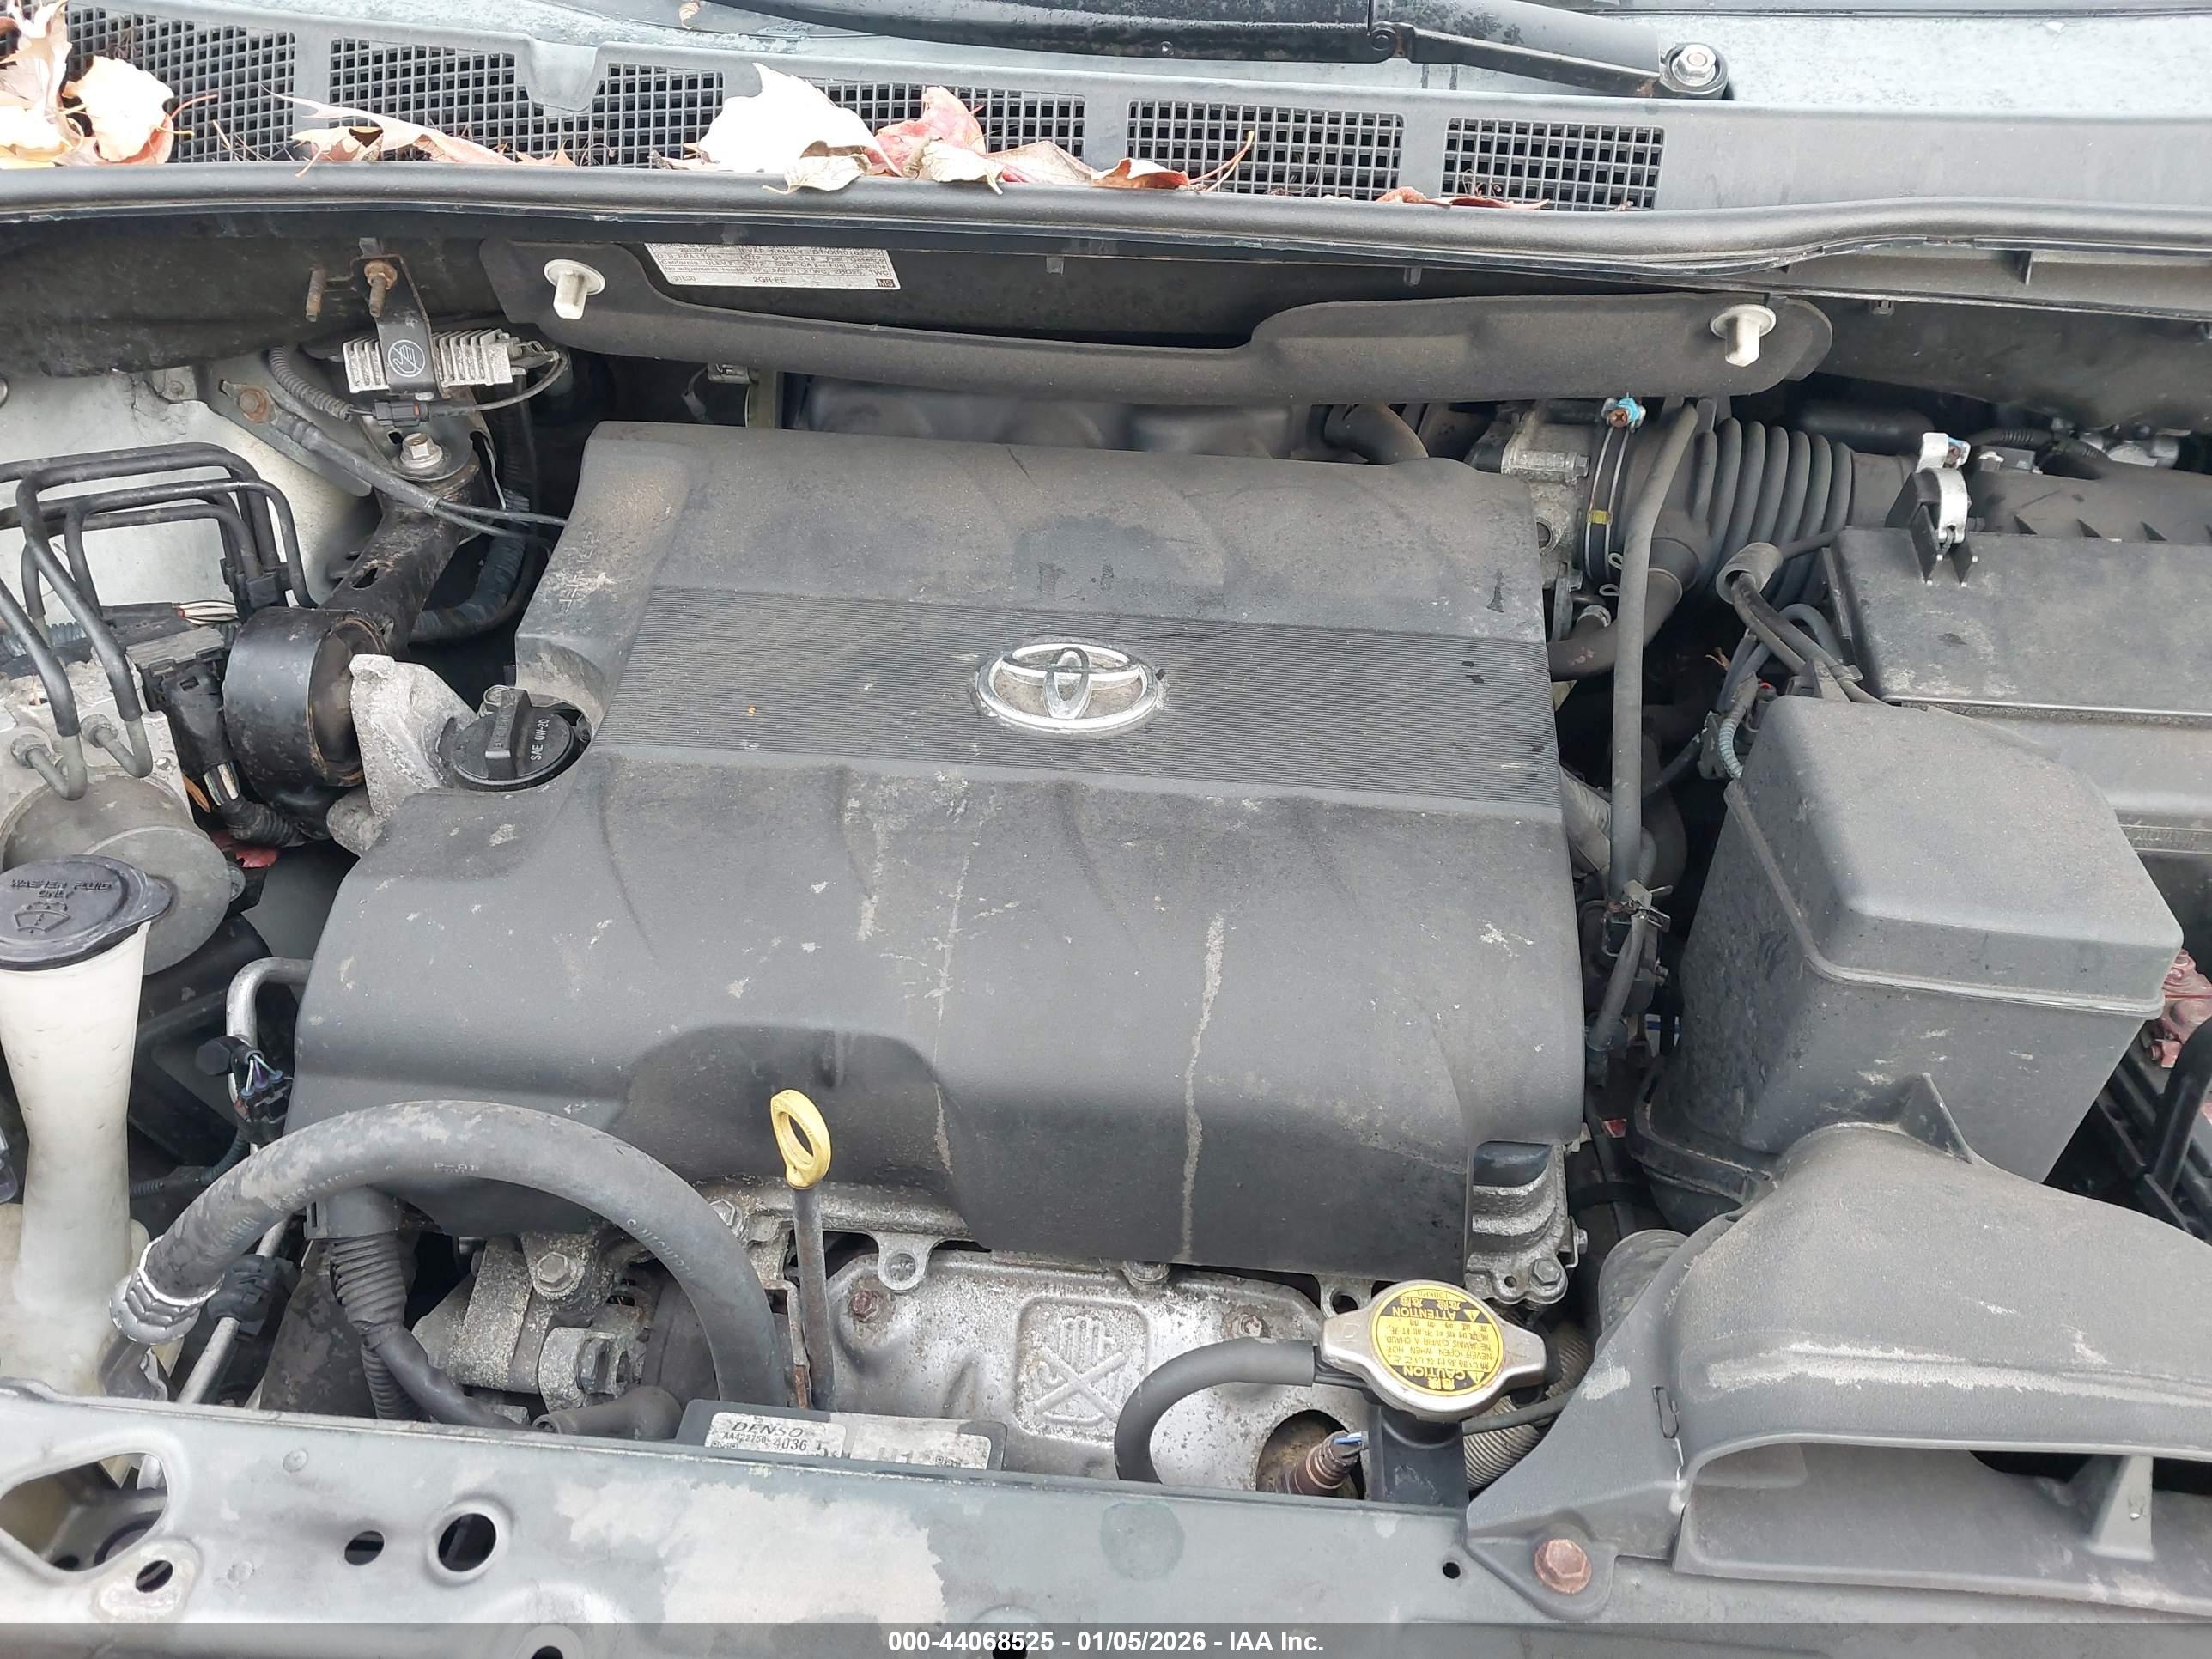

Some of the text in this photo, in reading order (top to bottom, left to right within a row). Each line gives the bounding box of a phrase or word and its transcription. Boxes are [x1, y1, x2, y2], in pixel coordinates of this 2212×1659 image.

[530, 718, 550, 761] SAE 0W-20
[1392, 1306, 1457, 1321] ATTENTION
[1410, 1346, 1432, 1355] WHEN
[1439, 1348, 1461, 1357] OPEN
[1466, 1352, 1492, 1360] NEVER
[1403, 1365, 1467, 1381] CAUTION
[732, 1420, 804, 1437] DENSO
